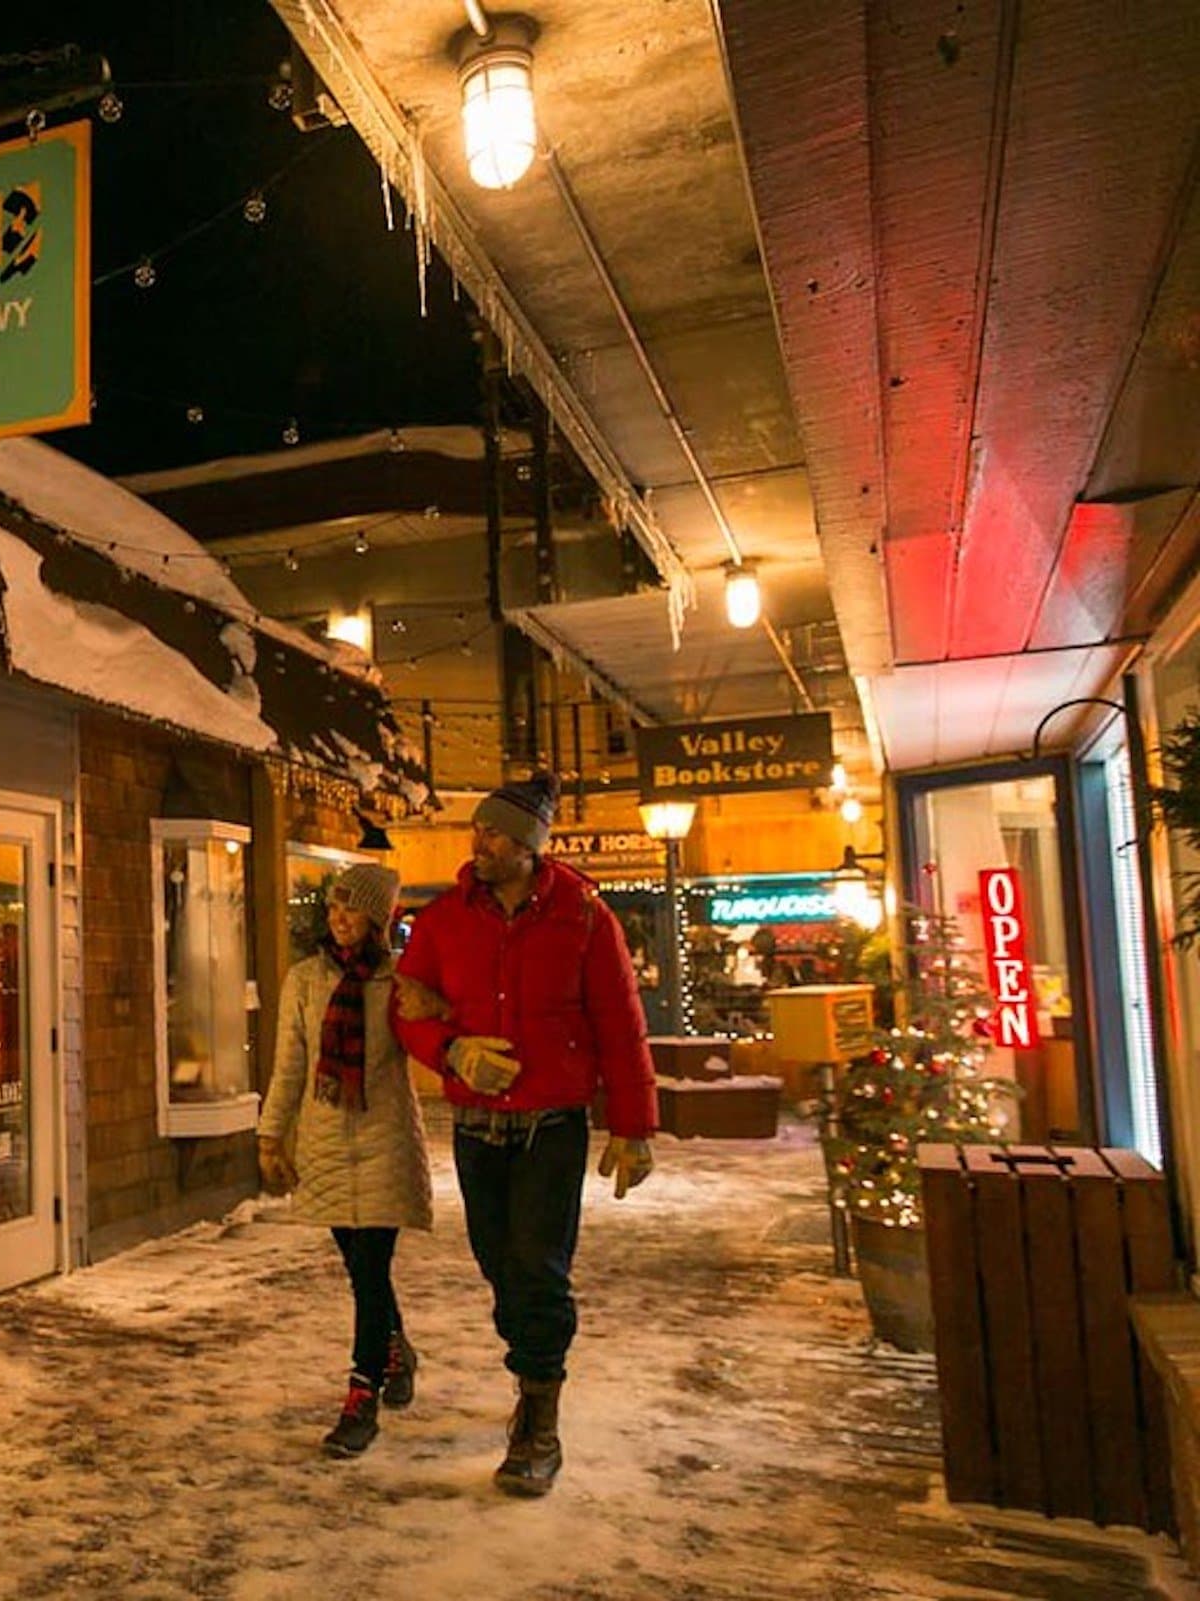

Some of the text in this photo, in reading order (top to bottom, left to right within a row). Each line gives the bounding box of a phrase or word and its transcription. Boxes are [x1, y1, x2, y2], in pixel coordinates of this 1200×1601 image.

[679, 730, 784, 757] Valley
[653, 760, 820, 788] Bookstore
[541, 835, 593, 854] RAZY
[988, 872, 1030, 1046] OPEN
